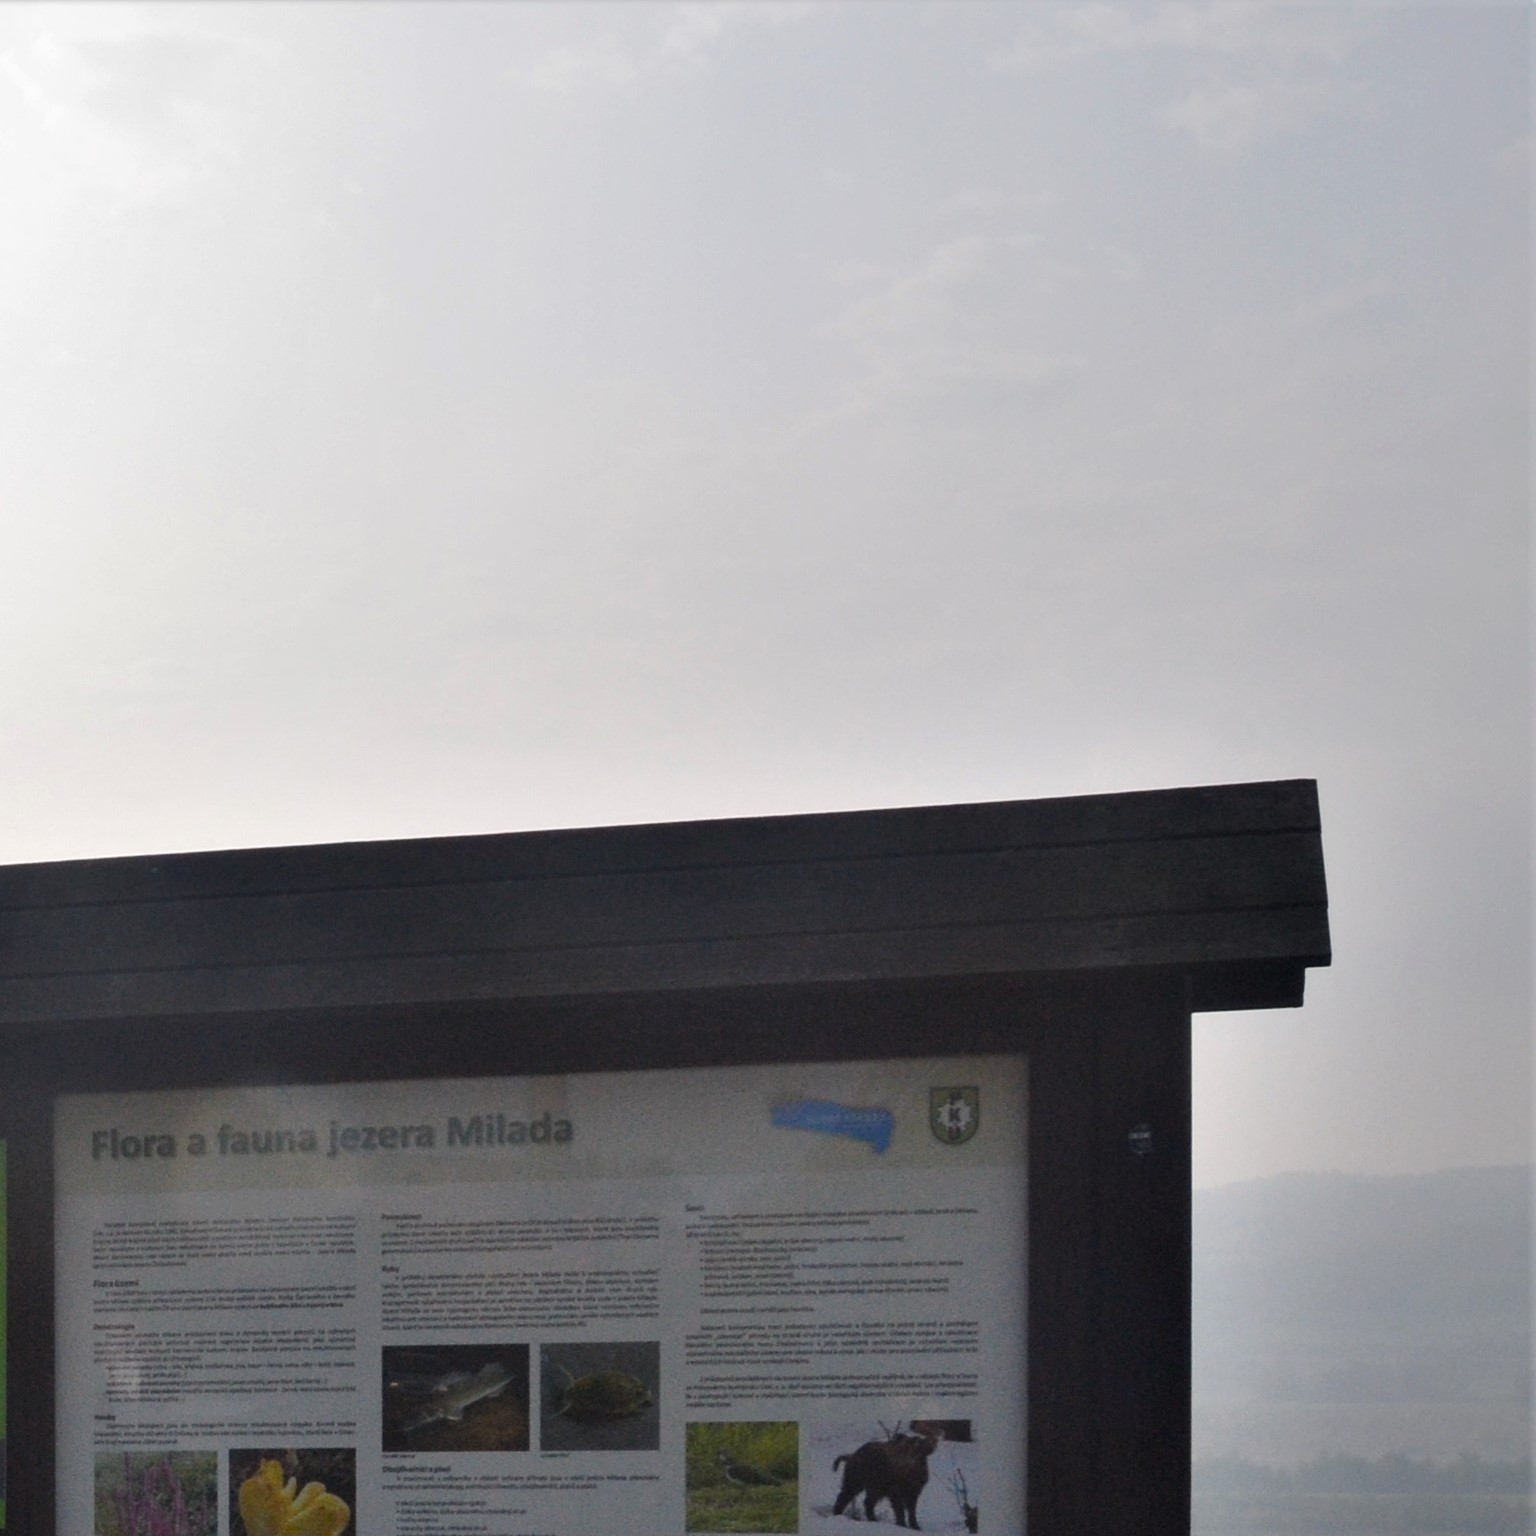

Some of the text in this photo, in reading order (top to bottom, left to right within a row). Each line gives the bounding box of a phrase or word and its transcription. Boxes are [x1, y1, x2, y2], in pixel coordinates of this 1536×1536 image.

[92, 1112, 574, 1159] Flora a fauna jezera Milada
